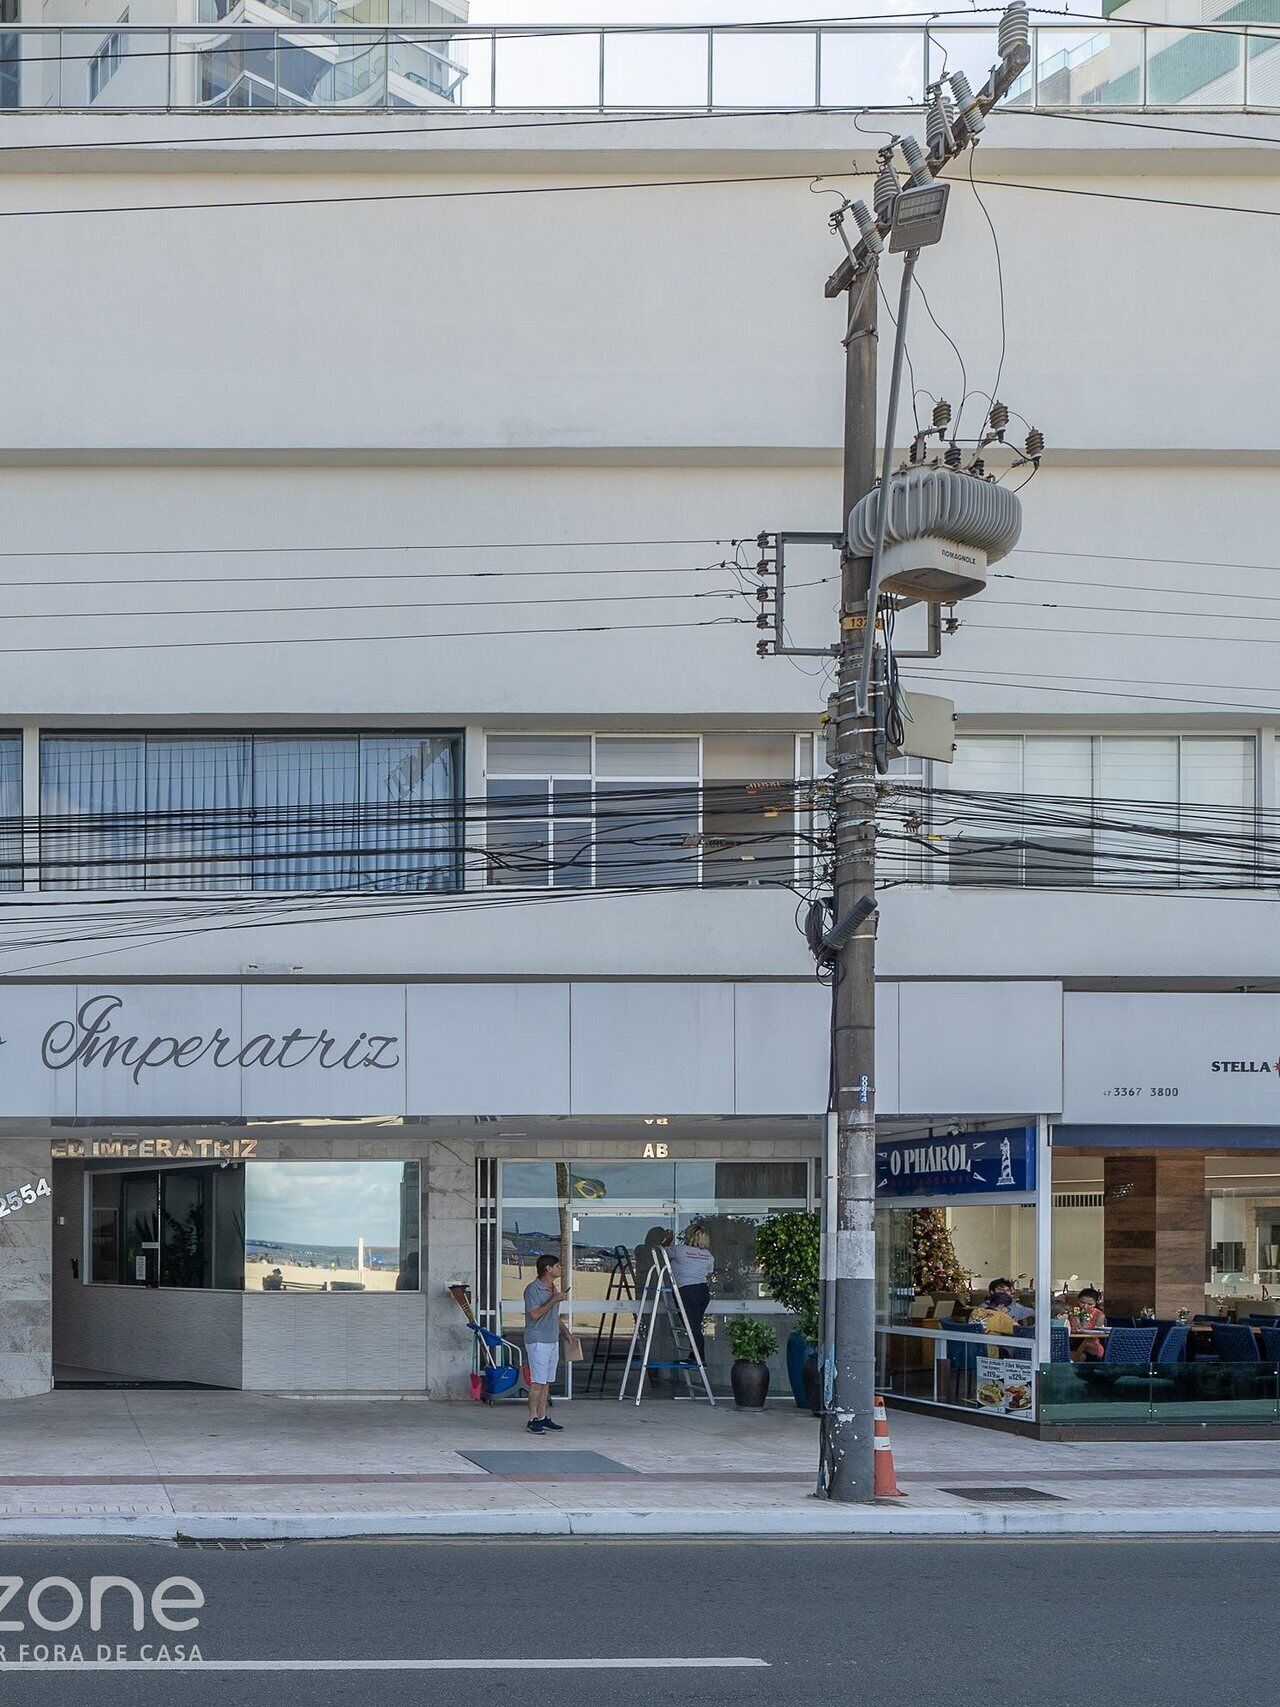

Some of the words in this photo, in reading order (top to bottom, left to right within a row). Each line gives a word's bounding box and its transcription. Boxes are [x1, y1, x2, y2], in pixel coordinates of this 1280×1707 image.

[941, 549, 976, 565] ROMAGNOLE
[42, 994, 400, 1085] Imperatriz
[1211, 1061, 1272, 1073] STELLA
[1113, 1087, 1142, 1097] 3367
[1150, 1087, 1179, 1097] 3800
[93, 1138, 258, 1158] IMPERATRIZ
[642, 1143, 669, 1158] AB
[890, 1150, 901, 1176] O
